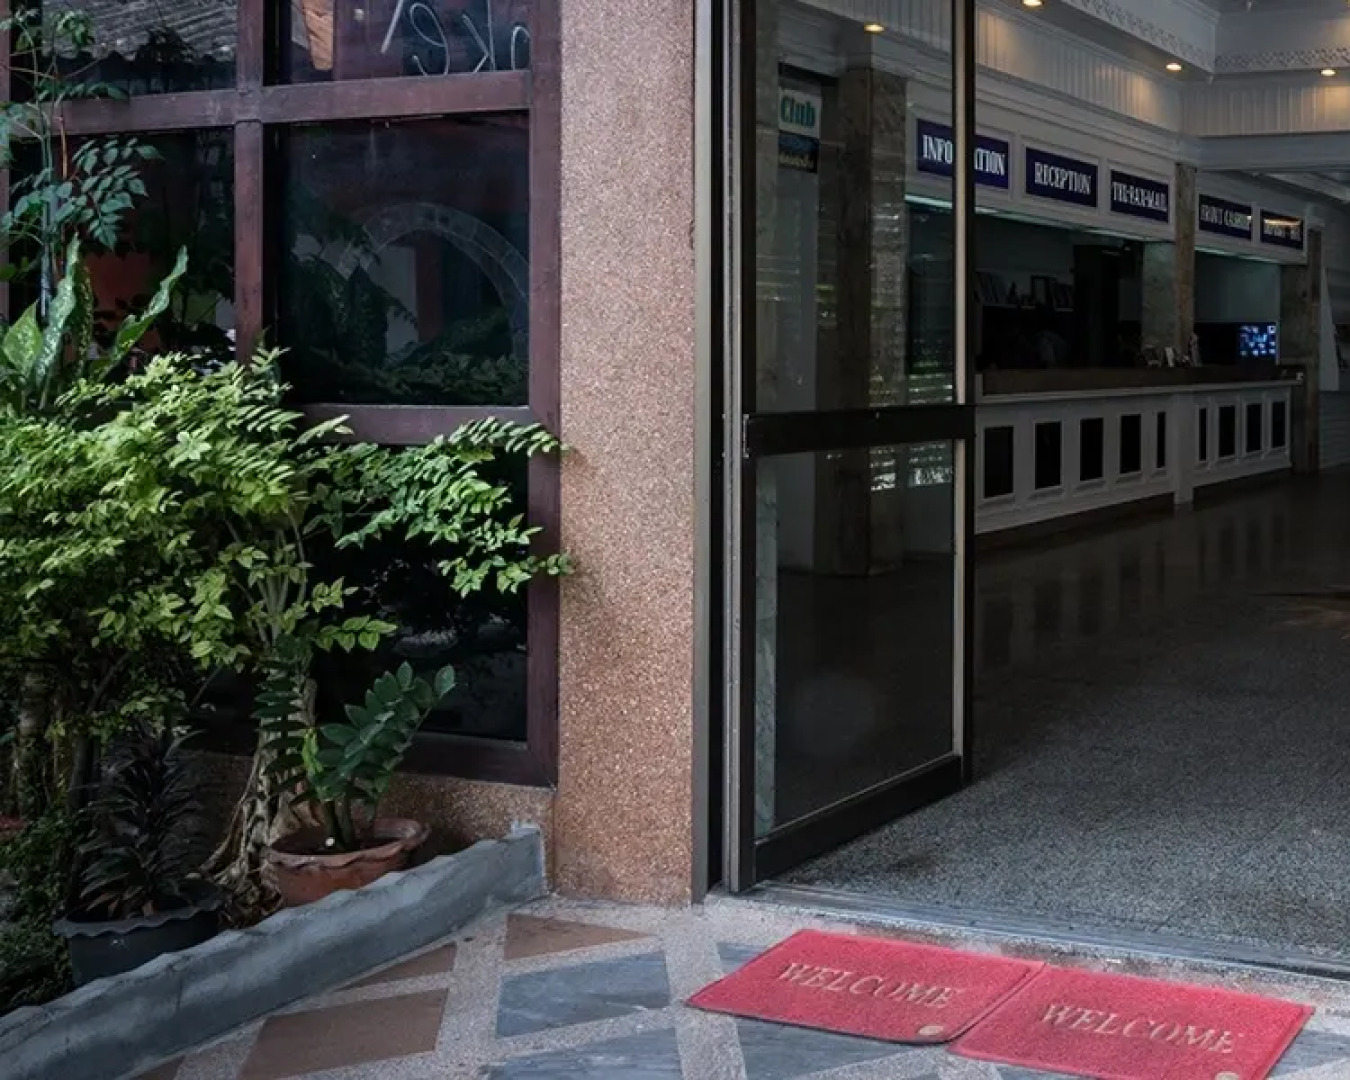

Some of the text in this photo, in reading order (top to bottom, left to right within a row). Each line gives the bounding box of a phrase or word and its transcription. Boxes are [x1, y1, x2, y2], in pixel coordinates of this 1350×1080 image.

[780, 94, 817, 129] Club
[1034, 161, 1092, 195] RECEPTION
[778, 961, 965, 1009] WELCOME
[1040, 1002, 1236, 1054] WELCOME
